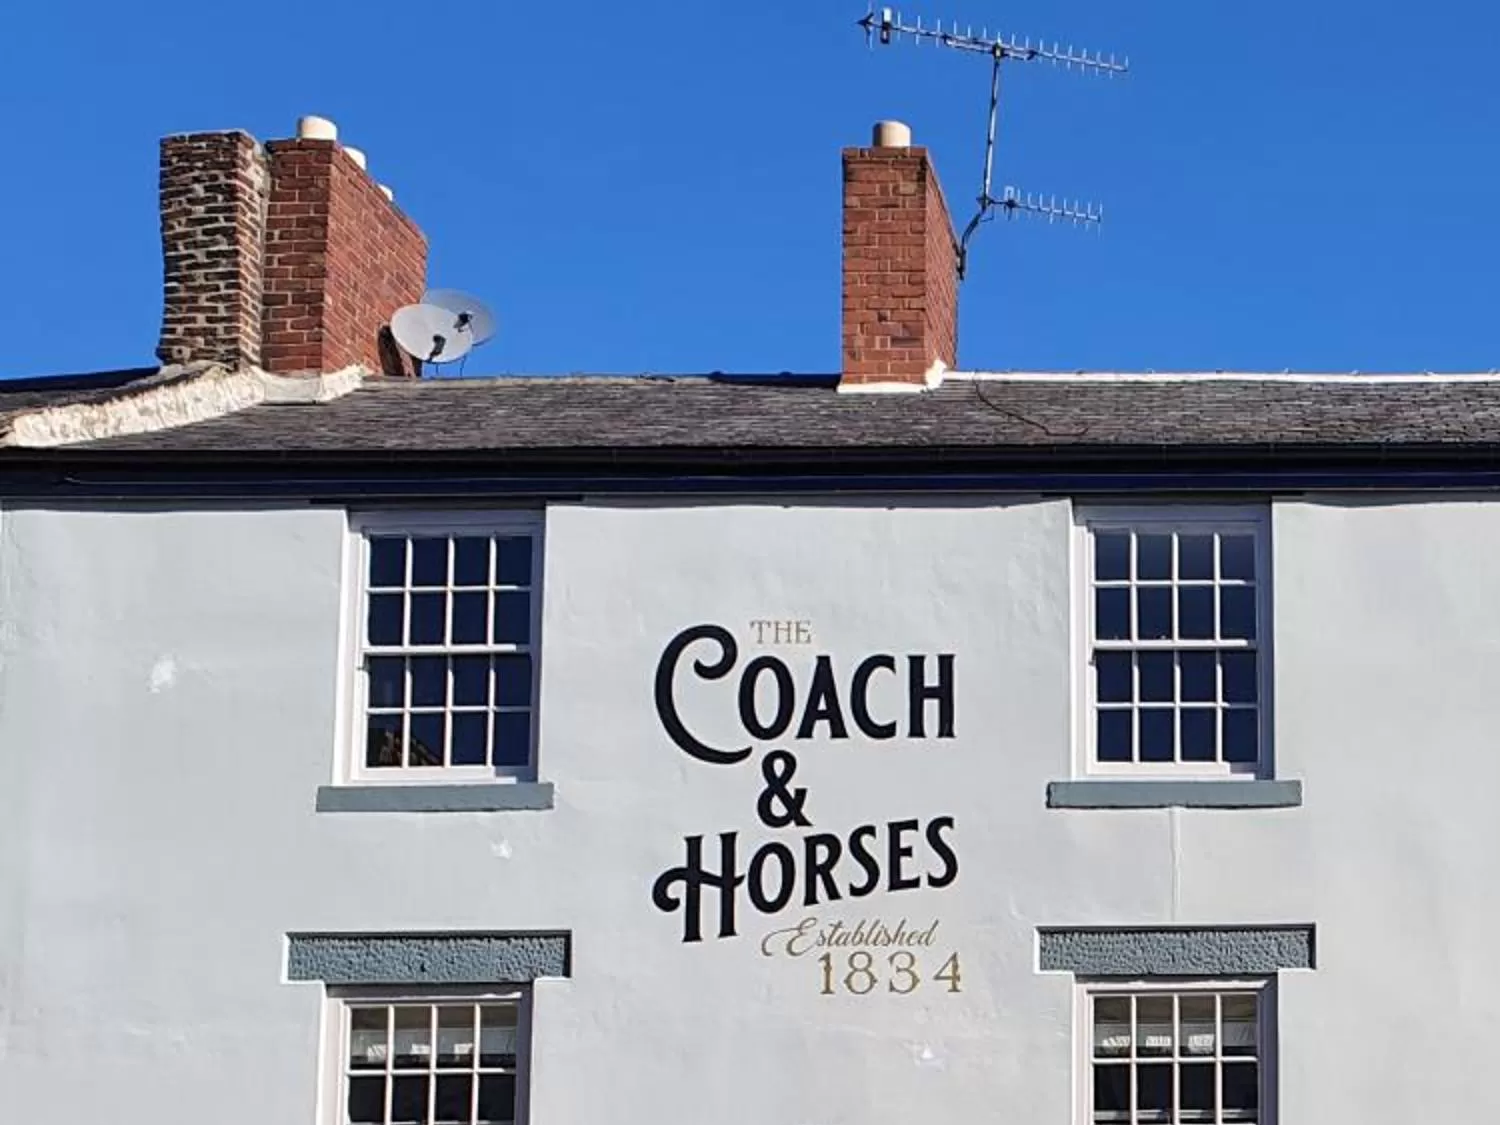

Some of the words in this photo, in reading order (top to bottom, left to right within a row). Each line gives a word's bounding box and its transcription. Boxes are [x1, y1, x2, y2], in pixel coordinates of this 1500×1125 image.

[749, 620, 812, 645] THE
[653, 623, 957, 765] COACH
[756, 749, 815, 829] &
[651, 815, 959, 943] HORSES
[761, 916, 940, 957] Established
[817, 950, 963, 995] 1834
